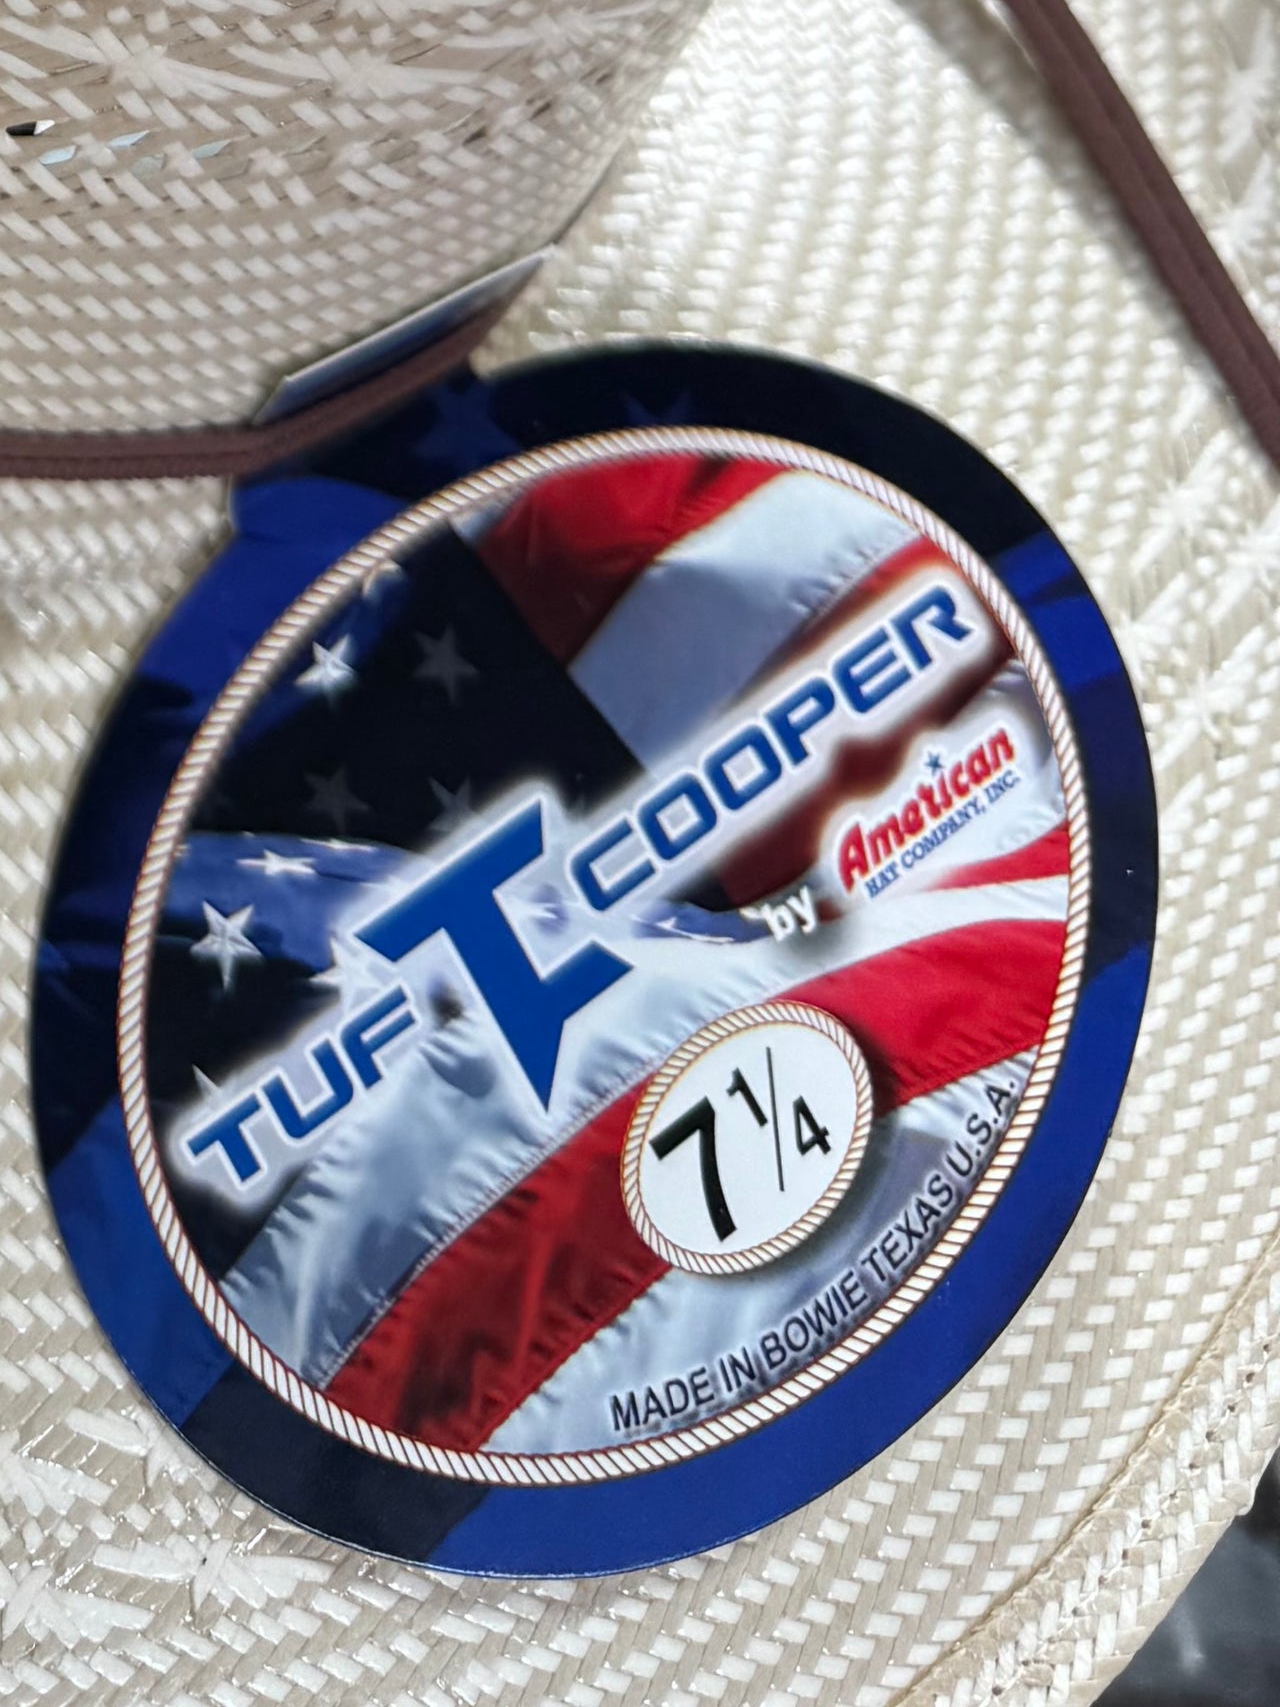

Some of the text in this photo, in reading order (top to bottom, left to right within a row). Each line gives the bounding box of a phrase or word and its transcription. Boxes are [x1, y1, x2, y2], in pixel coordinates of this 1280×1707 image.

[186, 988, 417, 1183] TUF
[570, 585, 973, 912] COOPER
[762, 728, 1015, 941] by American
[864, 769, 1022, 898] HAT COMPANY, INC.
[610, 1079, 1017, 1431] MADE IN BOWIE TEXAS U.S.A.
